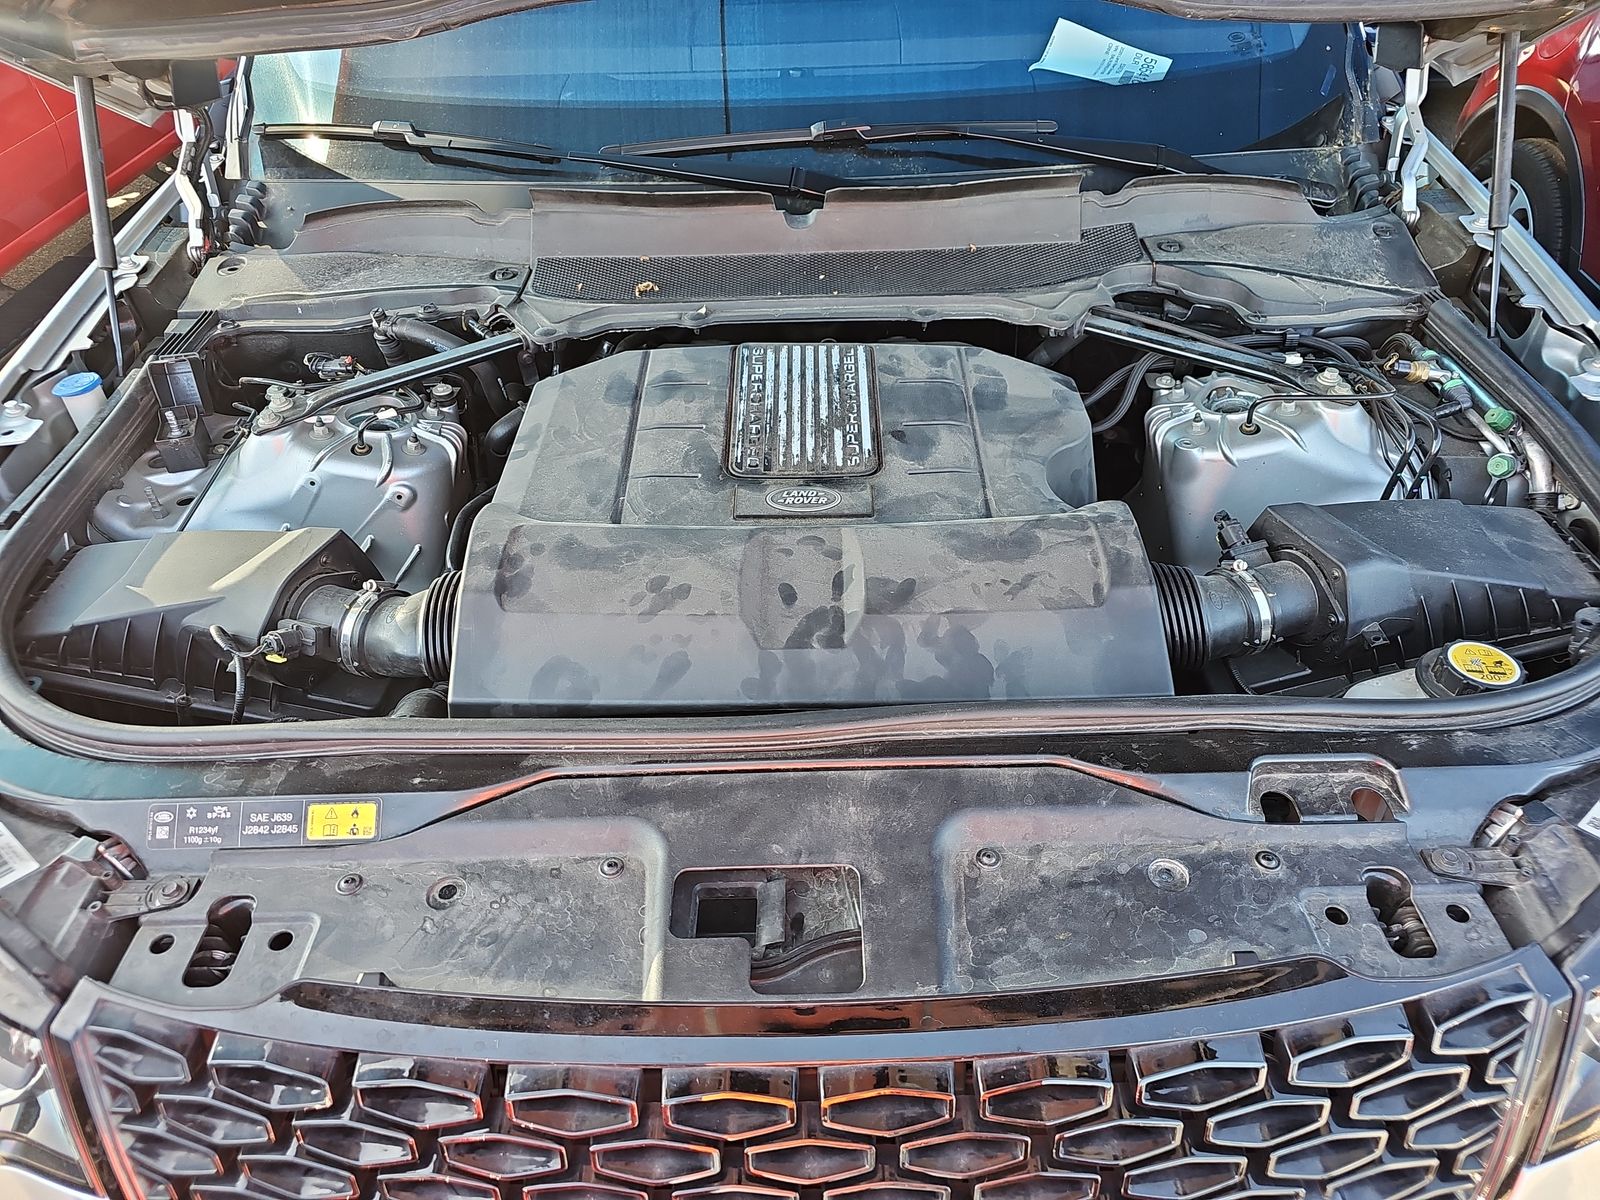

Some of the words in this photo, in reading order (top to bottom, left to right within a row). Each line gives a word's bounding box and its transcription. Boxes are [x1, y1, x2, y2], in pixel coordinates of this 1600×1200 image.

[782, 490, 818, 498] LAND
[784, 496, 828, 504] ROVER
[250, 812, 270, 823] SAE
[270, 812, 293, 822] J639
[188, 825, 219, 835] R1234yf
[242, 825, 270, 835] J2842
[270, 824, 299, 834] J2845
[183, 835, 203, 845] 1100g
